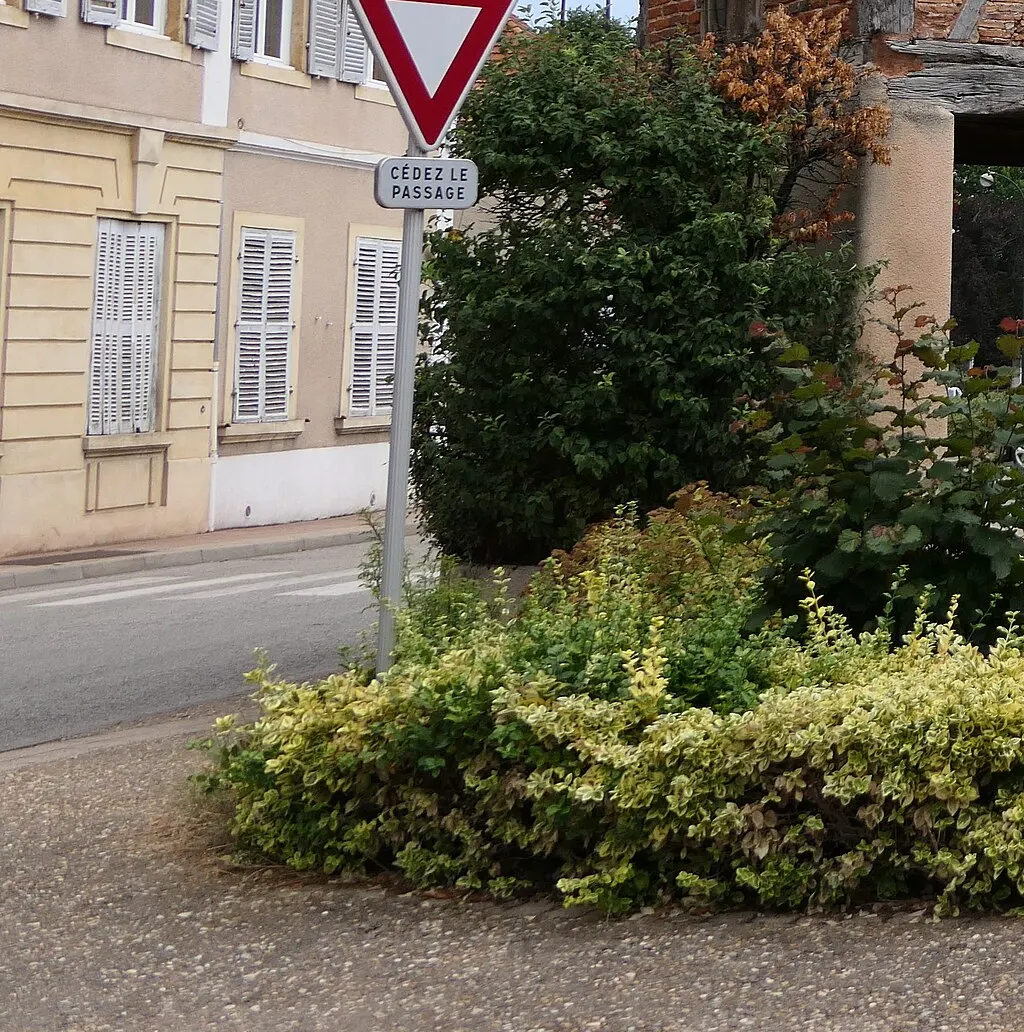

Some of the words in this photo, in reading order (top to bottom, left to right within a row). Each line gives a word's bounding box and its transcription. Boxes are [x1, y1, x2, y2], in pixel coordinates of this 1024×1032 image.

[390, 163, 443, 181] CÉDEZ
[451, 167, 468, 181] LE
[392, 185, 465, 200] PASSAGE
